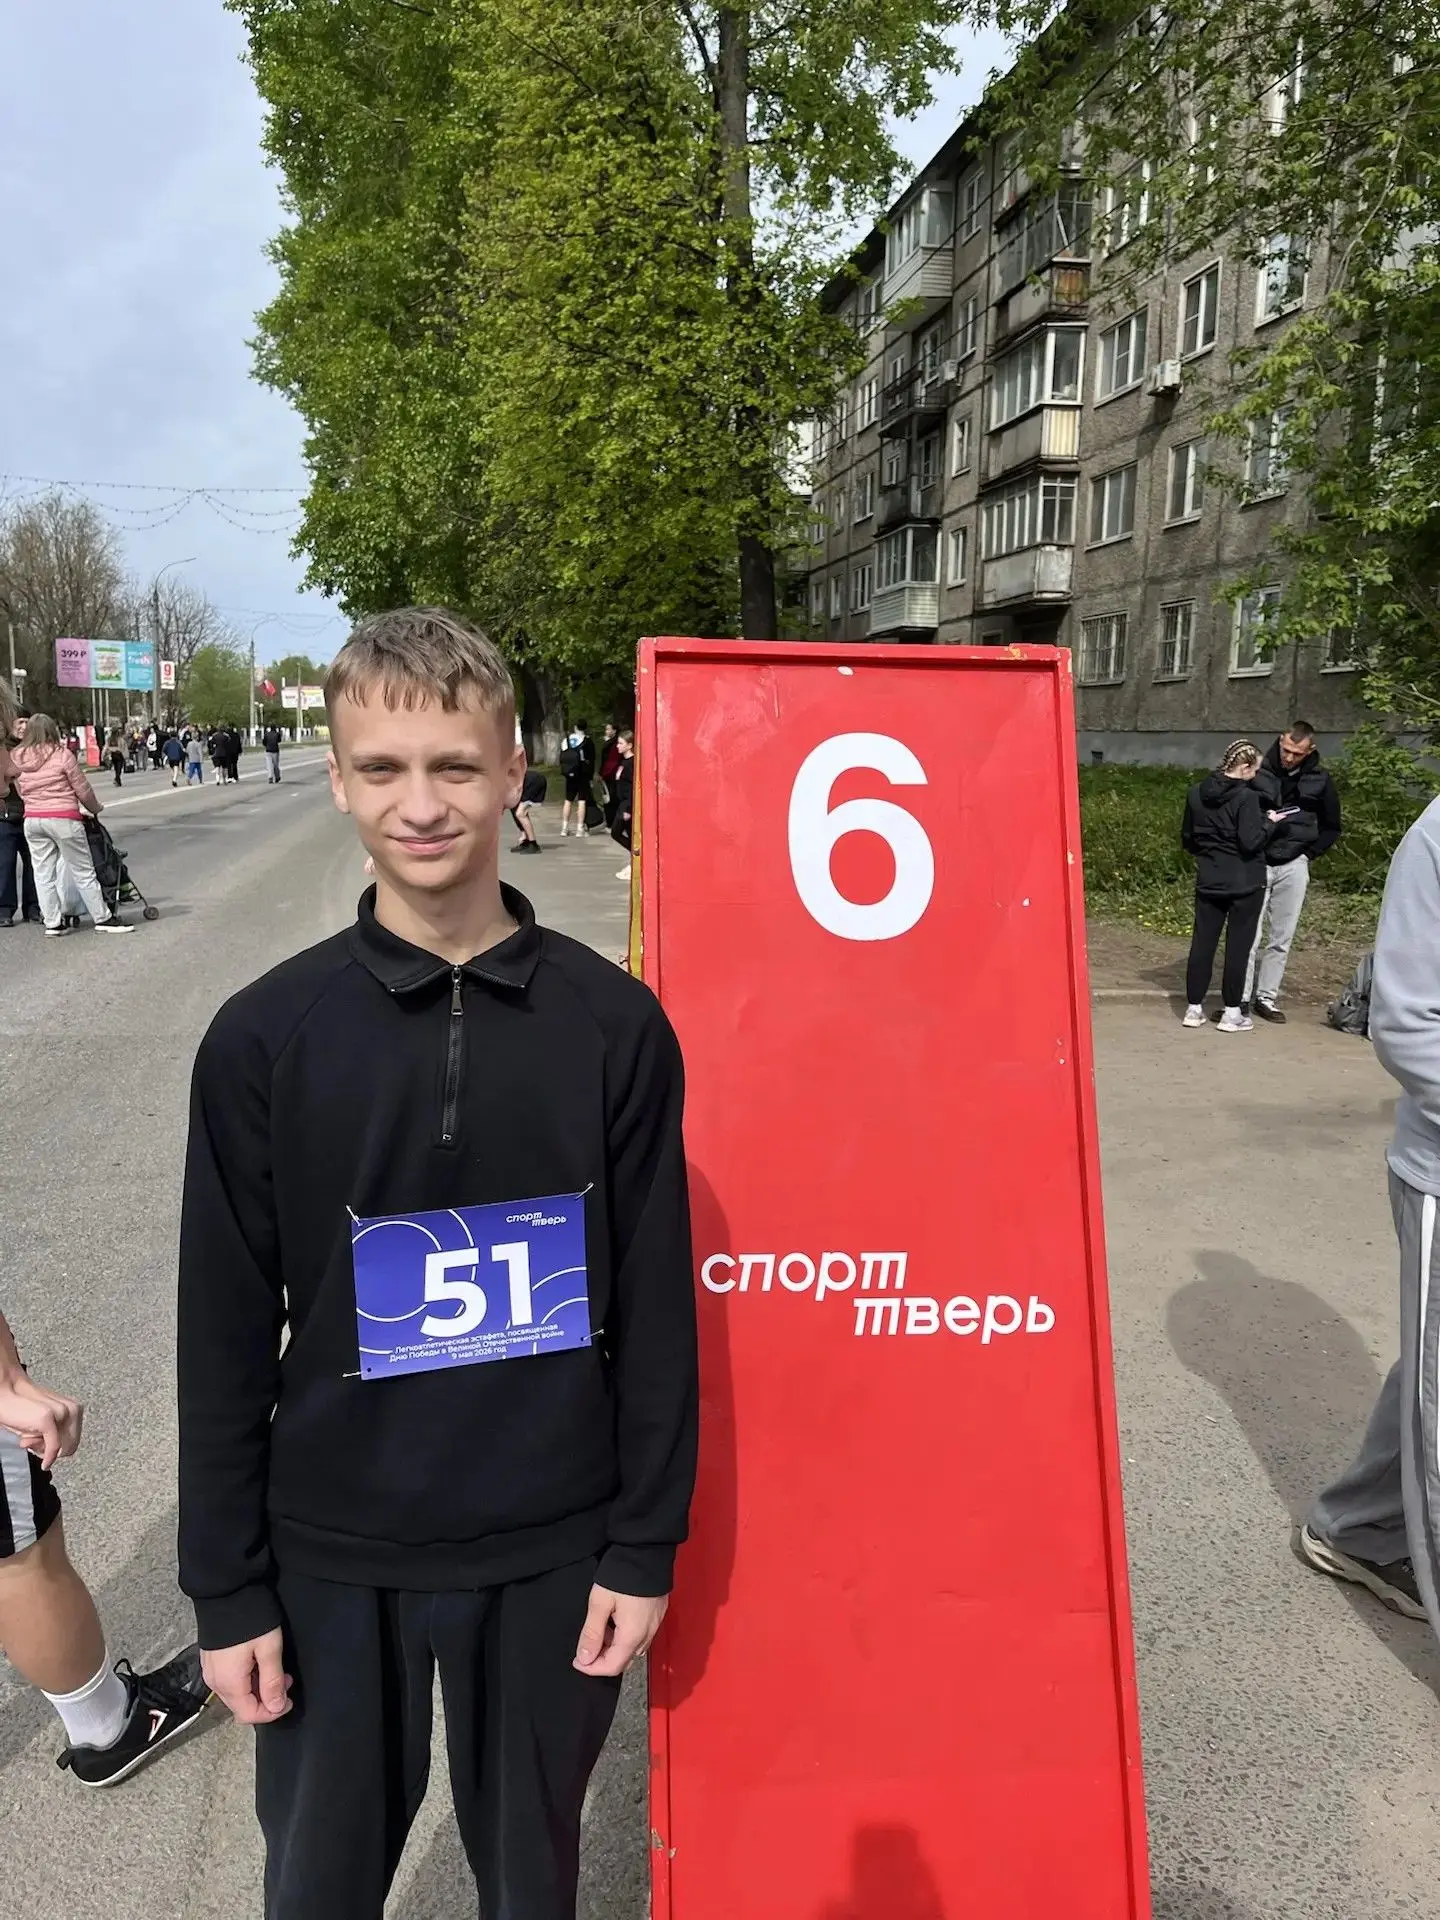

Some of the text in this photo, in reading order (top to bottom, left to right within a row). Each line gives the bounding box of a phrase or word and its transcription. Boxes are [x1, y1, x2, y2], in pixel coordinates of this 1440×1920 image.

[61, 649, 79, 658] 399
[788, 732, 934, 941] 6
[506, 1212, 542, 1223] спорт
[532, 1216, 567, 1226] тверь
[420, 1241, 533, 1337] 51
[701, 1251, 908, 1302] спорт
[853, 1295, 1056, 1344] тверь
[389, 1353, 408, 1363] Дню
[409, 1349, 440, 1359] Победы
[447, 1342, 482, 1353] Великой
[482, 1334, 541, 1348] Отечественной
[541, 1330, 565, 1339] войне
